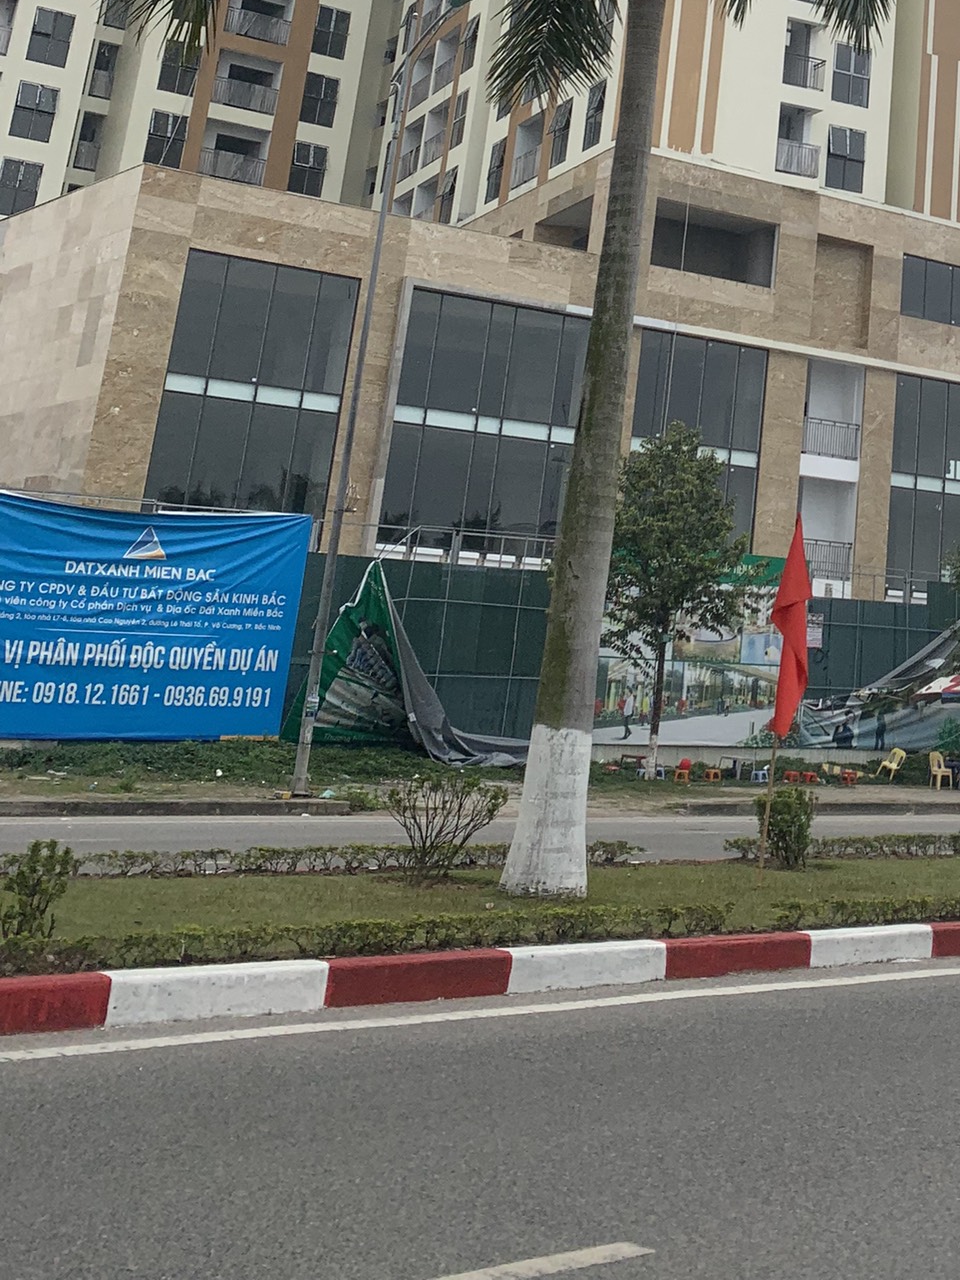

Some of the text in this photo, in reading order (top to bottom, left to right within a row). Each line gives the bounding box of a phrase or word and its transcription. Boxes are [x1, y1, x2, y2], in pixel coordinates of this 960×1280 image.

[144, 565, 182, 580] MIEN
[186, 568, 217, 581] BAC
[19, 581, 35, 593] TY
[38, 582, 75, 596] CPDV
[77, 585, 87, 596] &
[122, 587, 139, 599] TƯ
[140, 586, 163, 600] BẤT
[166, 588, 202, 604] ĐỘNG
[205, 588, 229, 604] SẢN
[231, 592, 259, 605] KINH
[261, 591, 287, 606] BẮC
[4, 595, 27, 606] viên
[29, 597, 56, 610] công
[58, 599, 68, 610] ty
[70, 598, 87, 609] Cổ
[116, 601, 138, 613] Dịch
[140, 604, 152, 614] vụ
[156, 604, 164, 613] &
[166, 604, 182, 615] Địa
[184, 604, 196, 614] ốc
[199, 605, 215, 615] Đất
[217, 606, 241, 616] Xanh
[266, 608, 284, 618] Bắc
[4, 637, 279, 675] VỊ PHÂN PHỐI ĐỘC QUYỀN DỰ ÁN
[163, 685, 271, 708] 0936.69.9191
